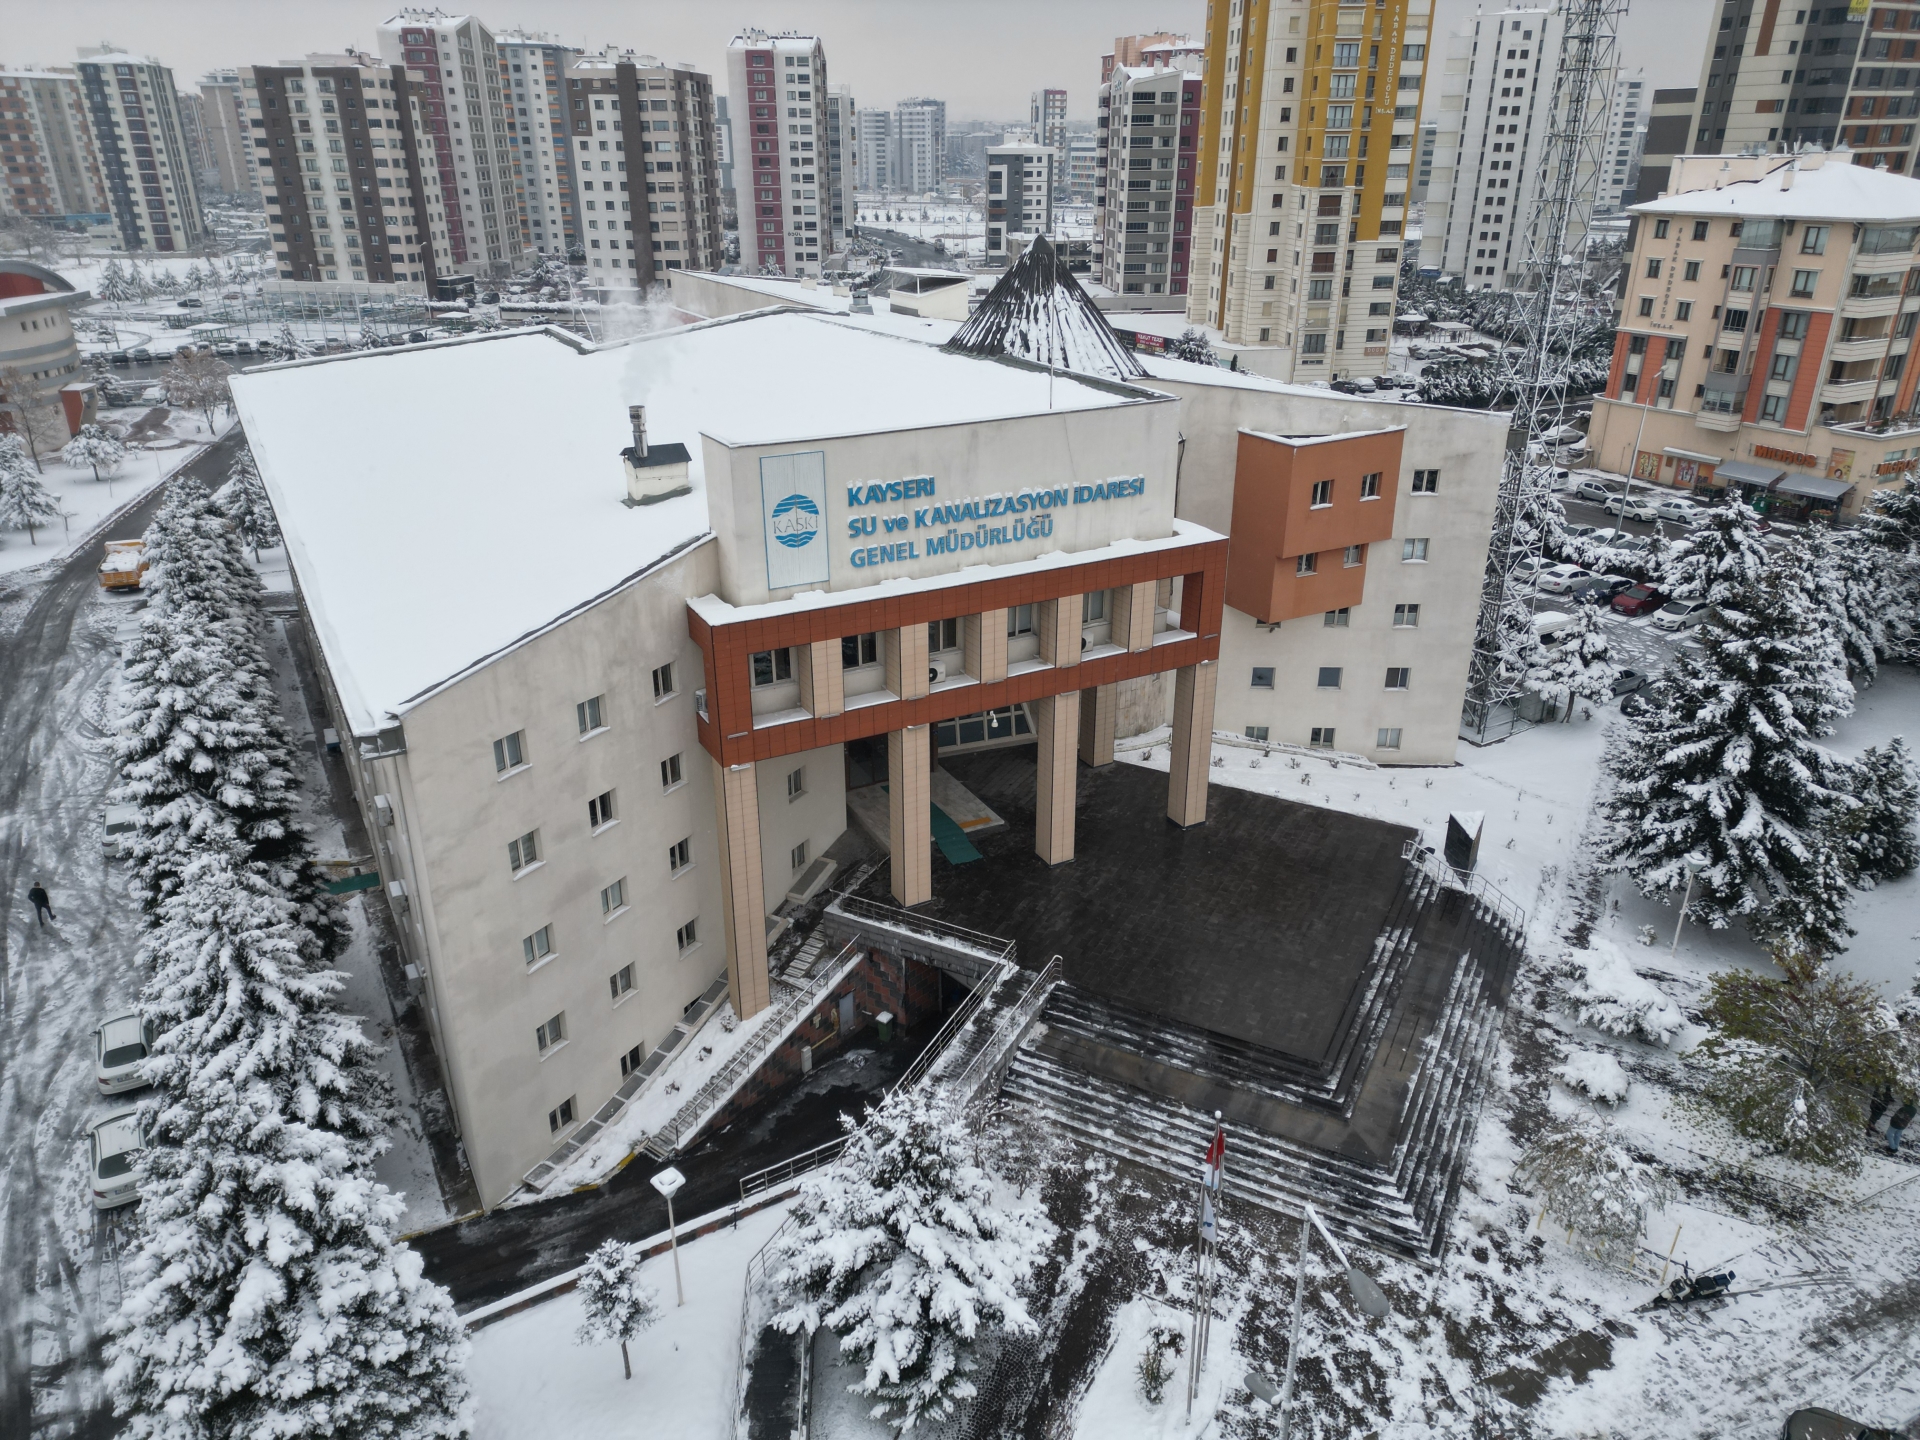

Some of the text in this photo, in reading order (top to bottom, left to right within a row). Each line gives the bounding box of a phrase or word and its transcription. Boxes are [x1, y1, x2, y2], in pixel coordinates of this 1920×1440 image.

[847, 475, 935, 507] KAYSERİ
[848, 475, 1145, 538] SU ve KANALİZASYON İDARESİ
[850, 514, 1053, 568] GENEL MÜDÜRLÜĞÜ
